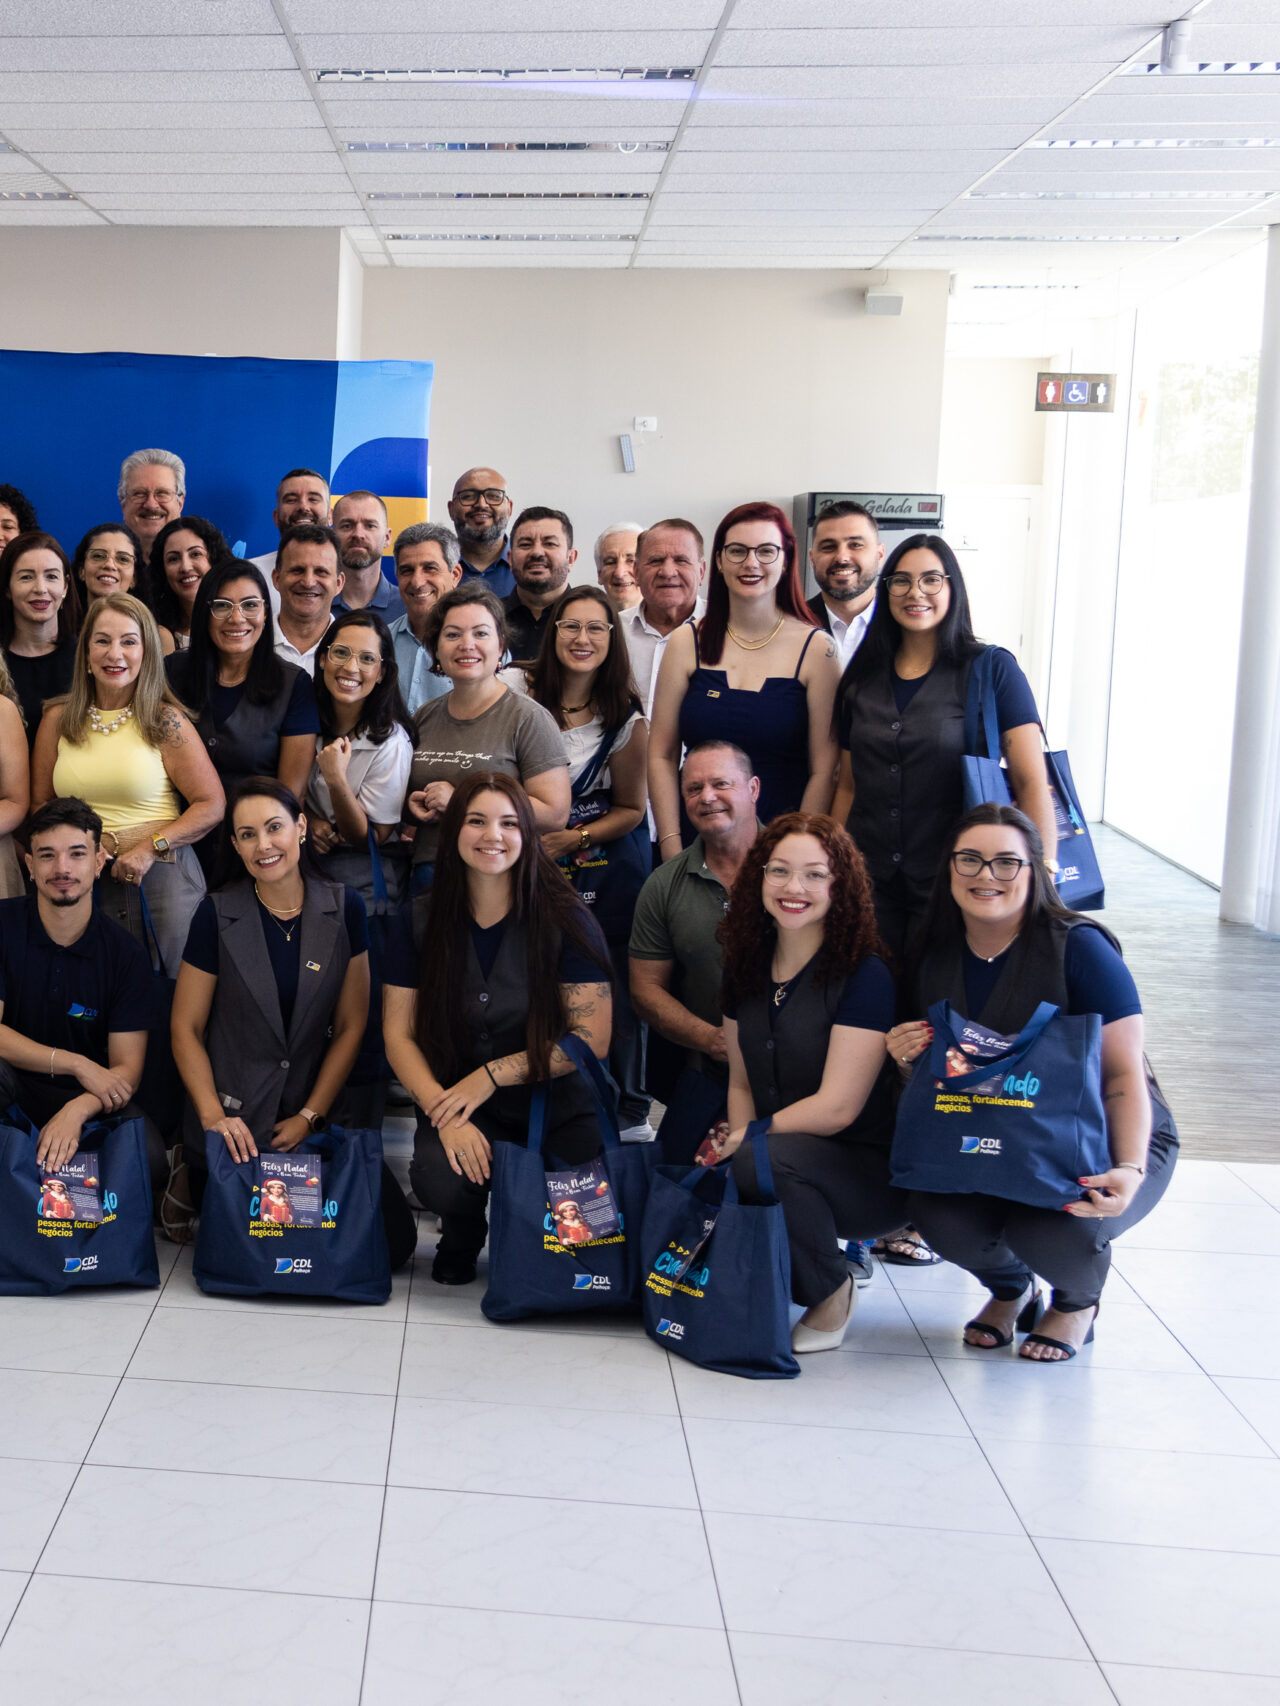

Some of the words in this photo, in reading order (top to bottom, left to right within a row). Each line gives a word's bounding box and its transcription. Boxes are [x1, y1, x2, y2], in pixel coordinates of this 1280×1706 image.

[864, 498, 912, 515] Gelada
[454, 750, 474, 760] things
[474, 752, 492, 760] that
[962, 1028, 984, 1042] Feliz
[936, 1094, 970, 1104] pessoas,
[972, 1094, 1034, 1108] fortalecendo
[934, 1103, 972, 1113] negócios
[980, 1138, 1002, 1149] CDL
[62, 1164, 86, 1173] Natal
[260, 1161, 281, 1172] Feliz
[284, 1162, 308, 1173] Natal
[547, 1180, 569, 1192] Feliz
[570, 1172, 595, 1188] Natal
[38, 1219, 72, 1229] pessoas,
[38, 1228, 73, 1238] negócios
[249, 1228, 284, 1238] negócios
[82, 1255, 98, 1266] CDL
[293, 1258, 312, 1268] CDL
[592, 1276, 611, 1284] CDL
[670, 1322, 685, 1335] CDL
